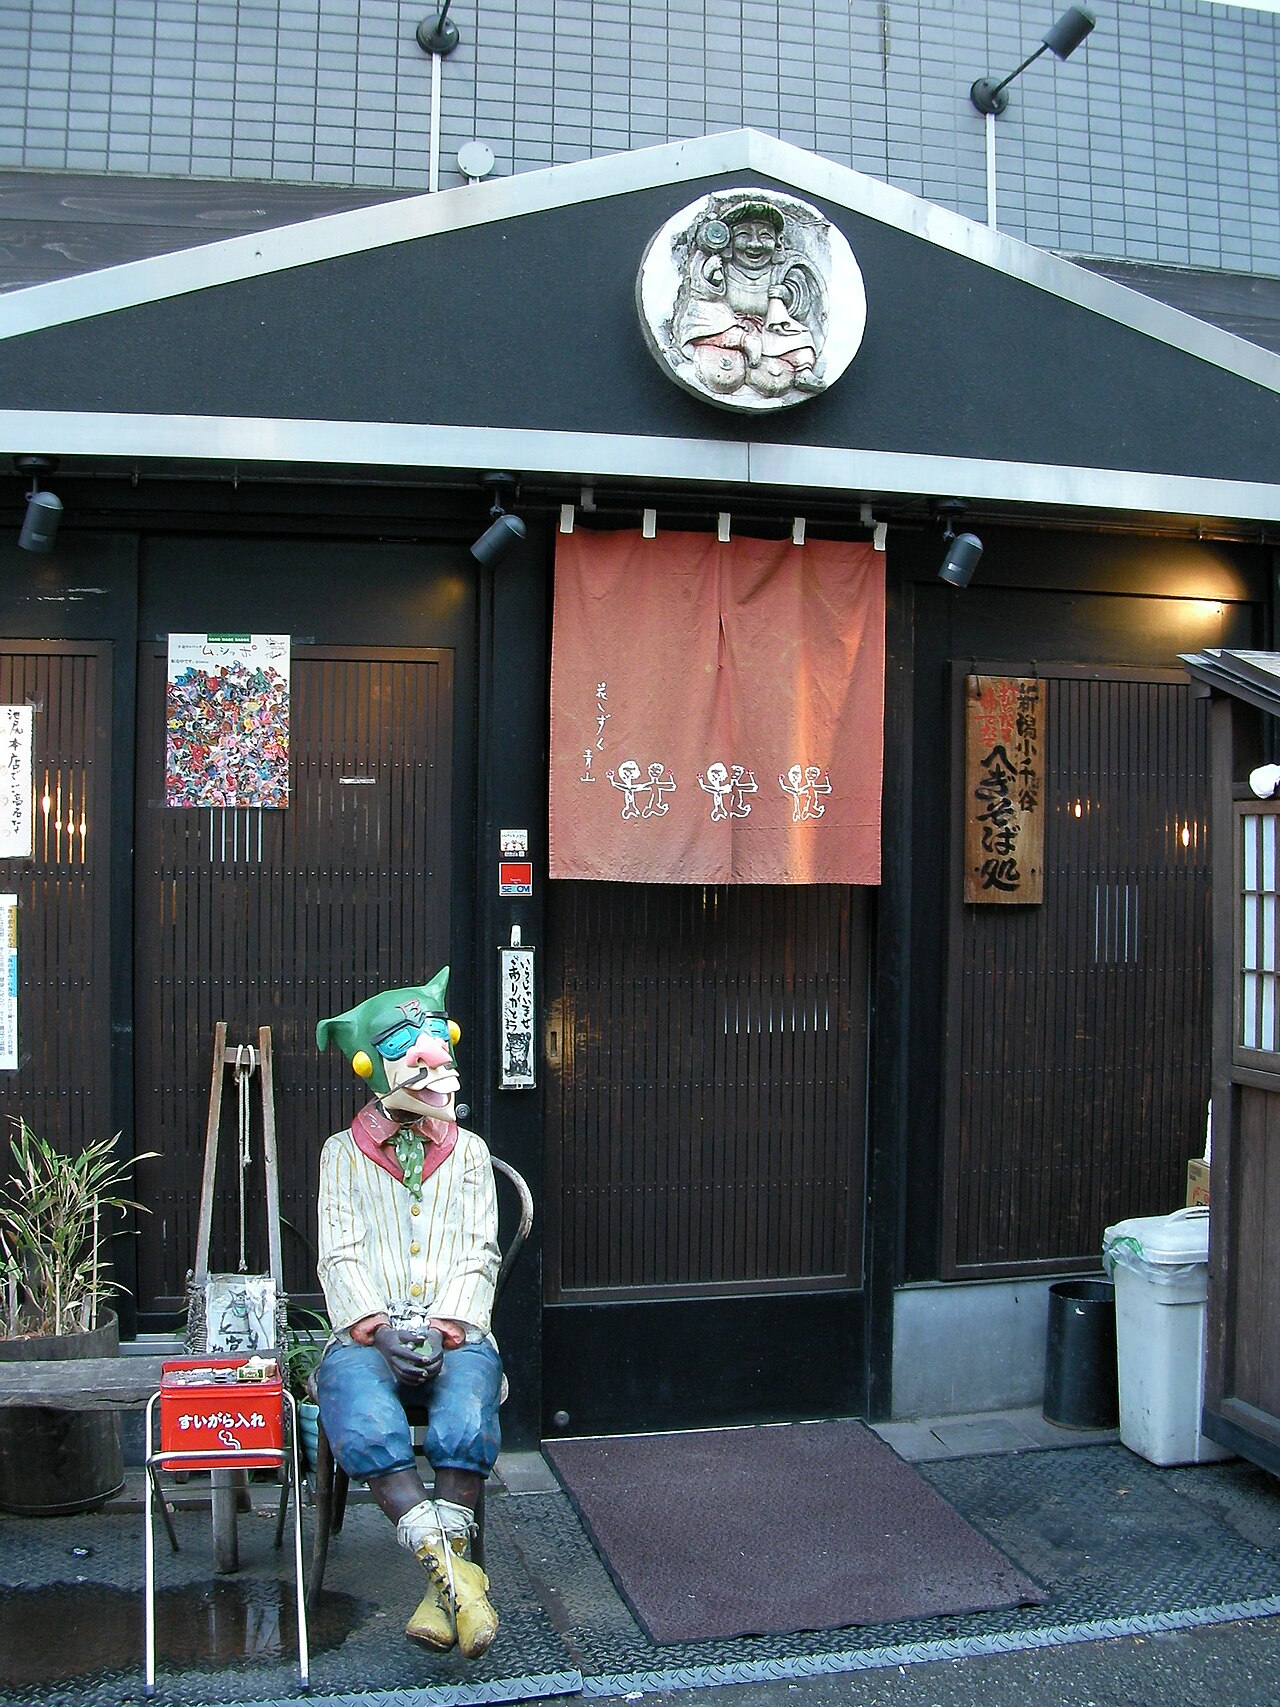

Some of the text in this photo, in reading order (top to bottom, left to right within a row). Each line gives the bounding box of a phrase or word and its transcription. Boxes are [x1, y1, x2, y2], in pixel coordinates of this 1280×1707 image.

[580, 748, 596, 782] 青山
[1016, 682, 1039, 813] 新潟小千谷
[975, 744, 1021, 892] へぎそば処
[178, 1411, 266, 1430] すいがら入れ
